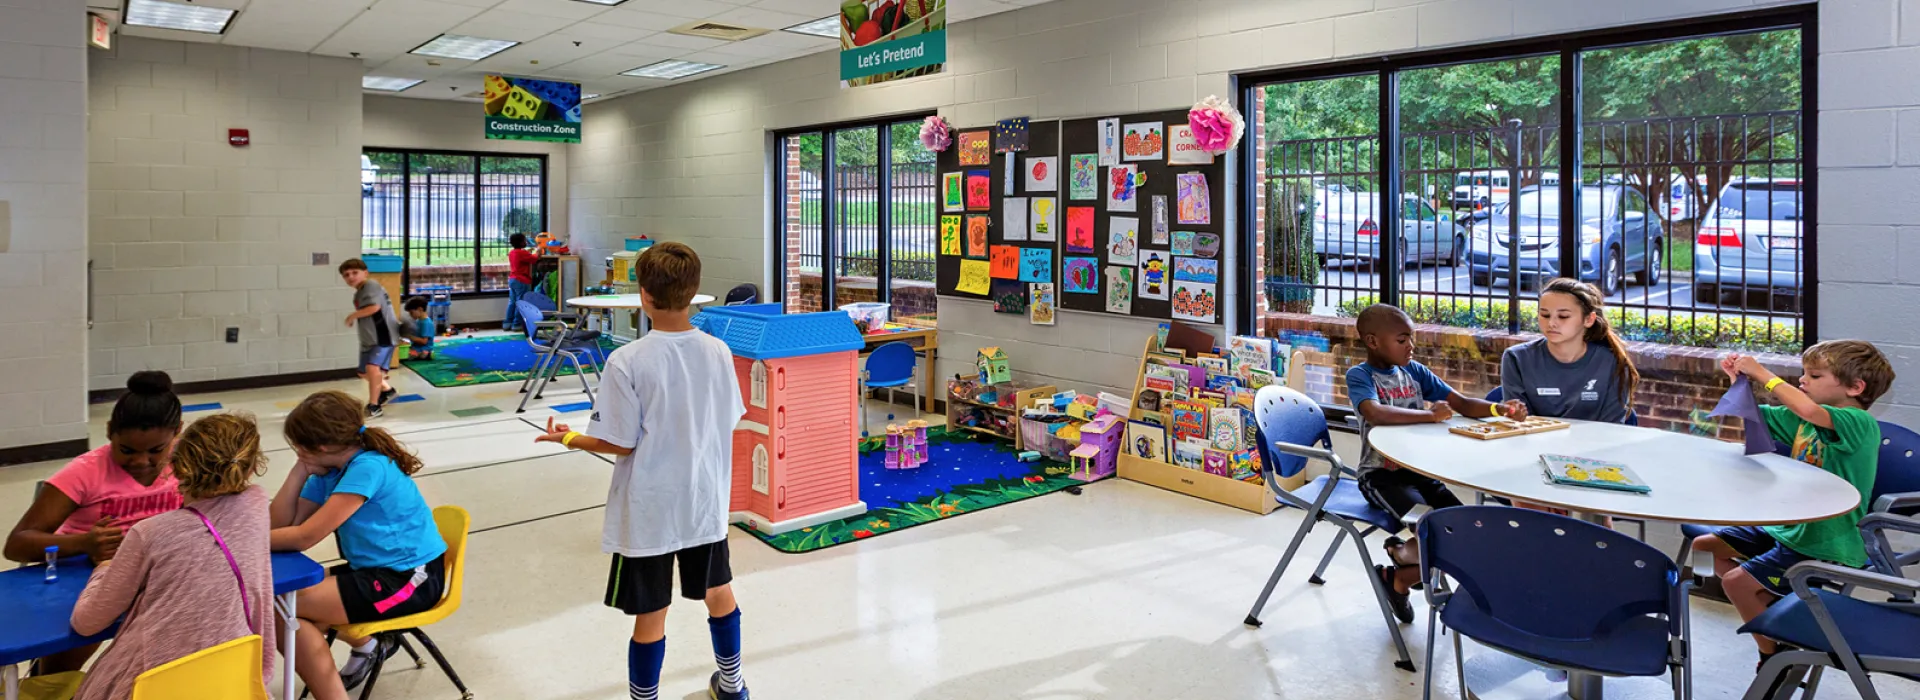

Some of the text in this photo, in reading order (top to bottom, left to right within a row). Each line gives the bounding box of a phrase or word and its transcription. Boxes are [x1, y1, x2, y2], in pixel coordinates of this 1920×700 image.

[858, 41, 924, 68] Let's Pretend
[490, 121, 576, 134] Construction Zone
[1180, 130, 1192, 138] CR
[1176, 143, 1204, 151] CORNE
